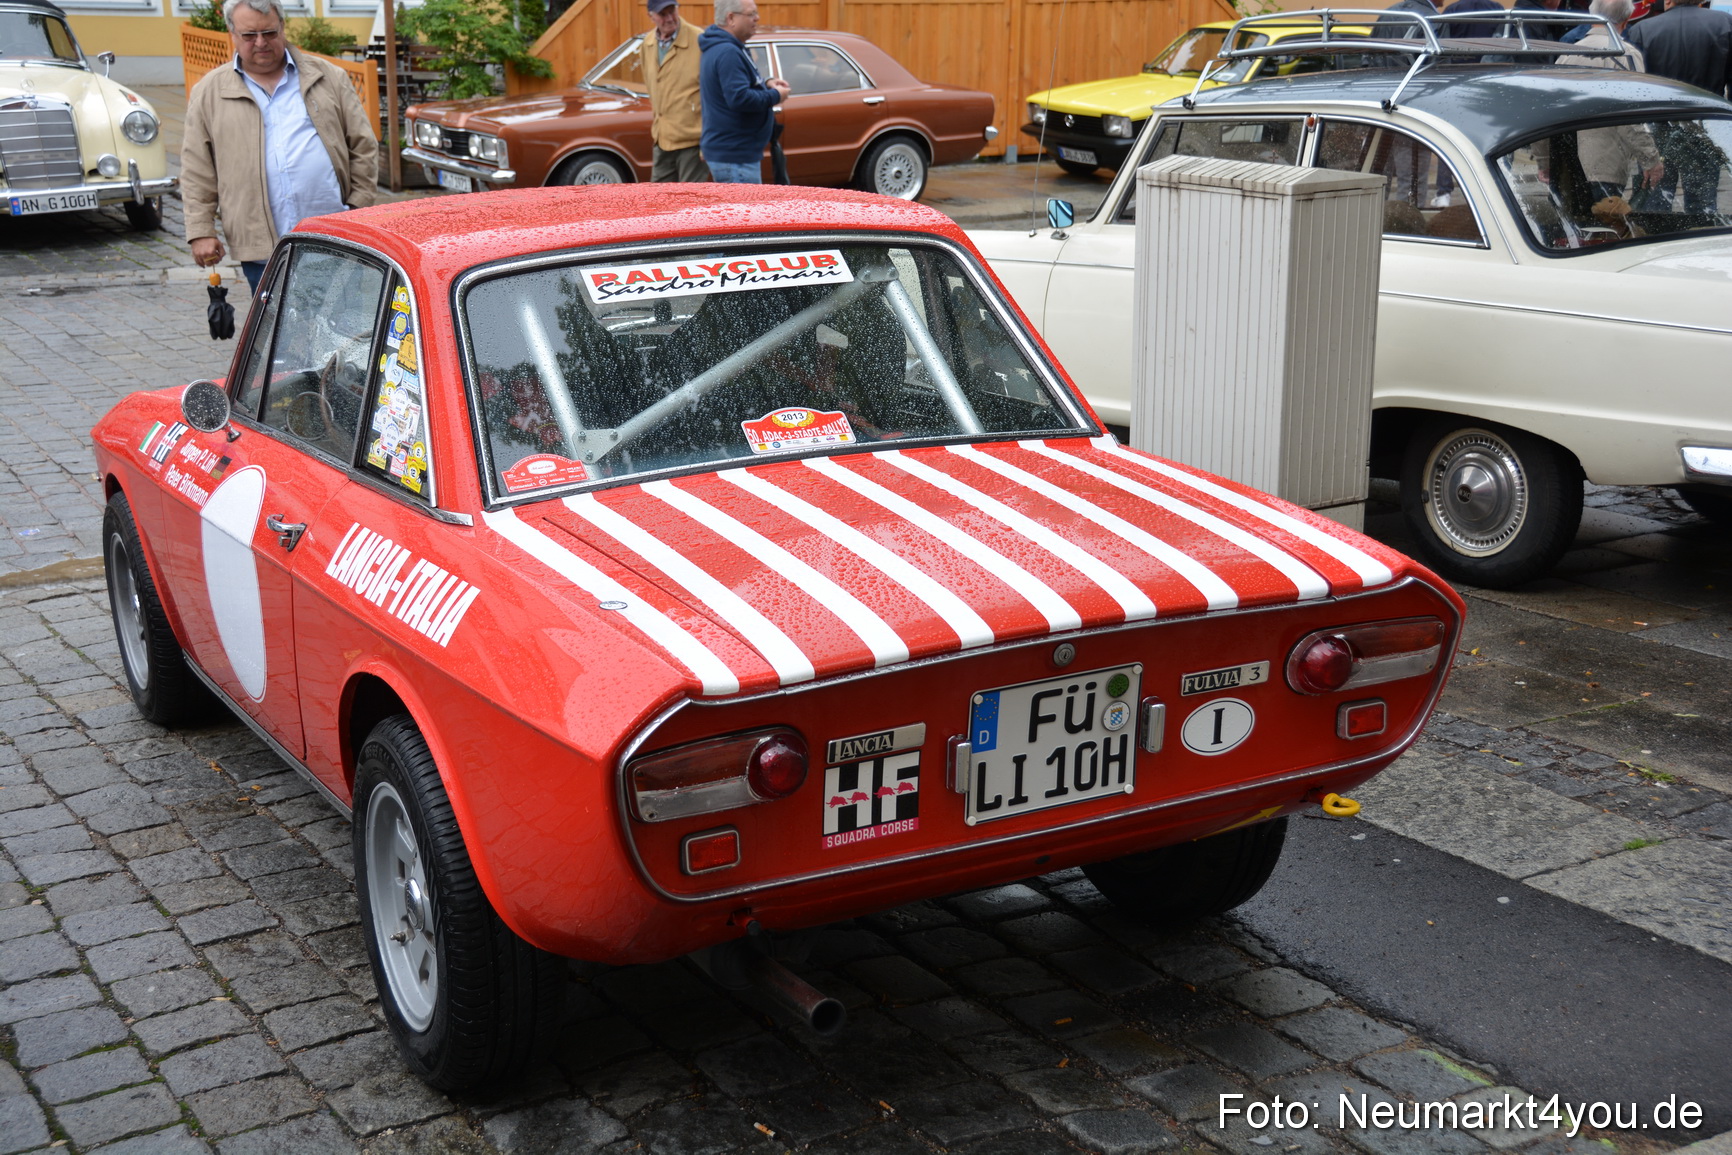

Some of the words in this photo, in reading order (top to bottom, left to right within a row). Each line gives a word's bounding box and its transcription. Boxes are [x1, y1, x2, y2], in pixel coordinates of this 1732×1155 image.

[22, 199, 39, 212] AN
[48, 197, 57, 210] G
[60, 194, 97, 209] 100H
[590, 254, 838, 287] RALLYCLUB
[597, 275, 714, 300] Sandro
[720, 265, 843, 287] Munari
[746, 428, 762, 443] 50.
[762, 418, 850, 442] ADAC-3-STÄDTE-RALLYE
[781, 412, 804, 421] 2013
[152, 421, 189, 463] HF
[180, 439, 202, 464] Jürgen
[164, 463, 183, 488] Peter
[178, 473, 209, 506] Birkmann
[325, 522, 481, 648] LANCIA-ITALIA
[1183, 670, 1240, 693] FULVIA
[1249, 667, 1260, 681] 3
[1028, 681, 1098, 743] FÜ
[1211, 707, 1225, 746] I
[834, 733, 894, 763] LANCIA
[979, 729, 990, 745] D
[976, 753, 1029, 812] LI
[1044, 734, 1128, 798] 10H
[823, 750, 920, 835] HF
[827, 827, 876, 848] SQUADRA
[881, 819, 914, 836] CORSE
